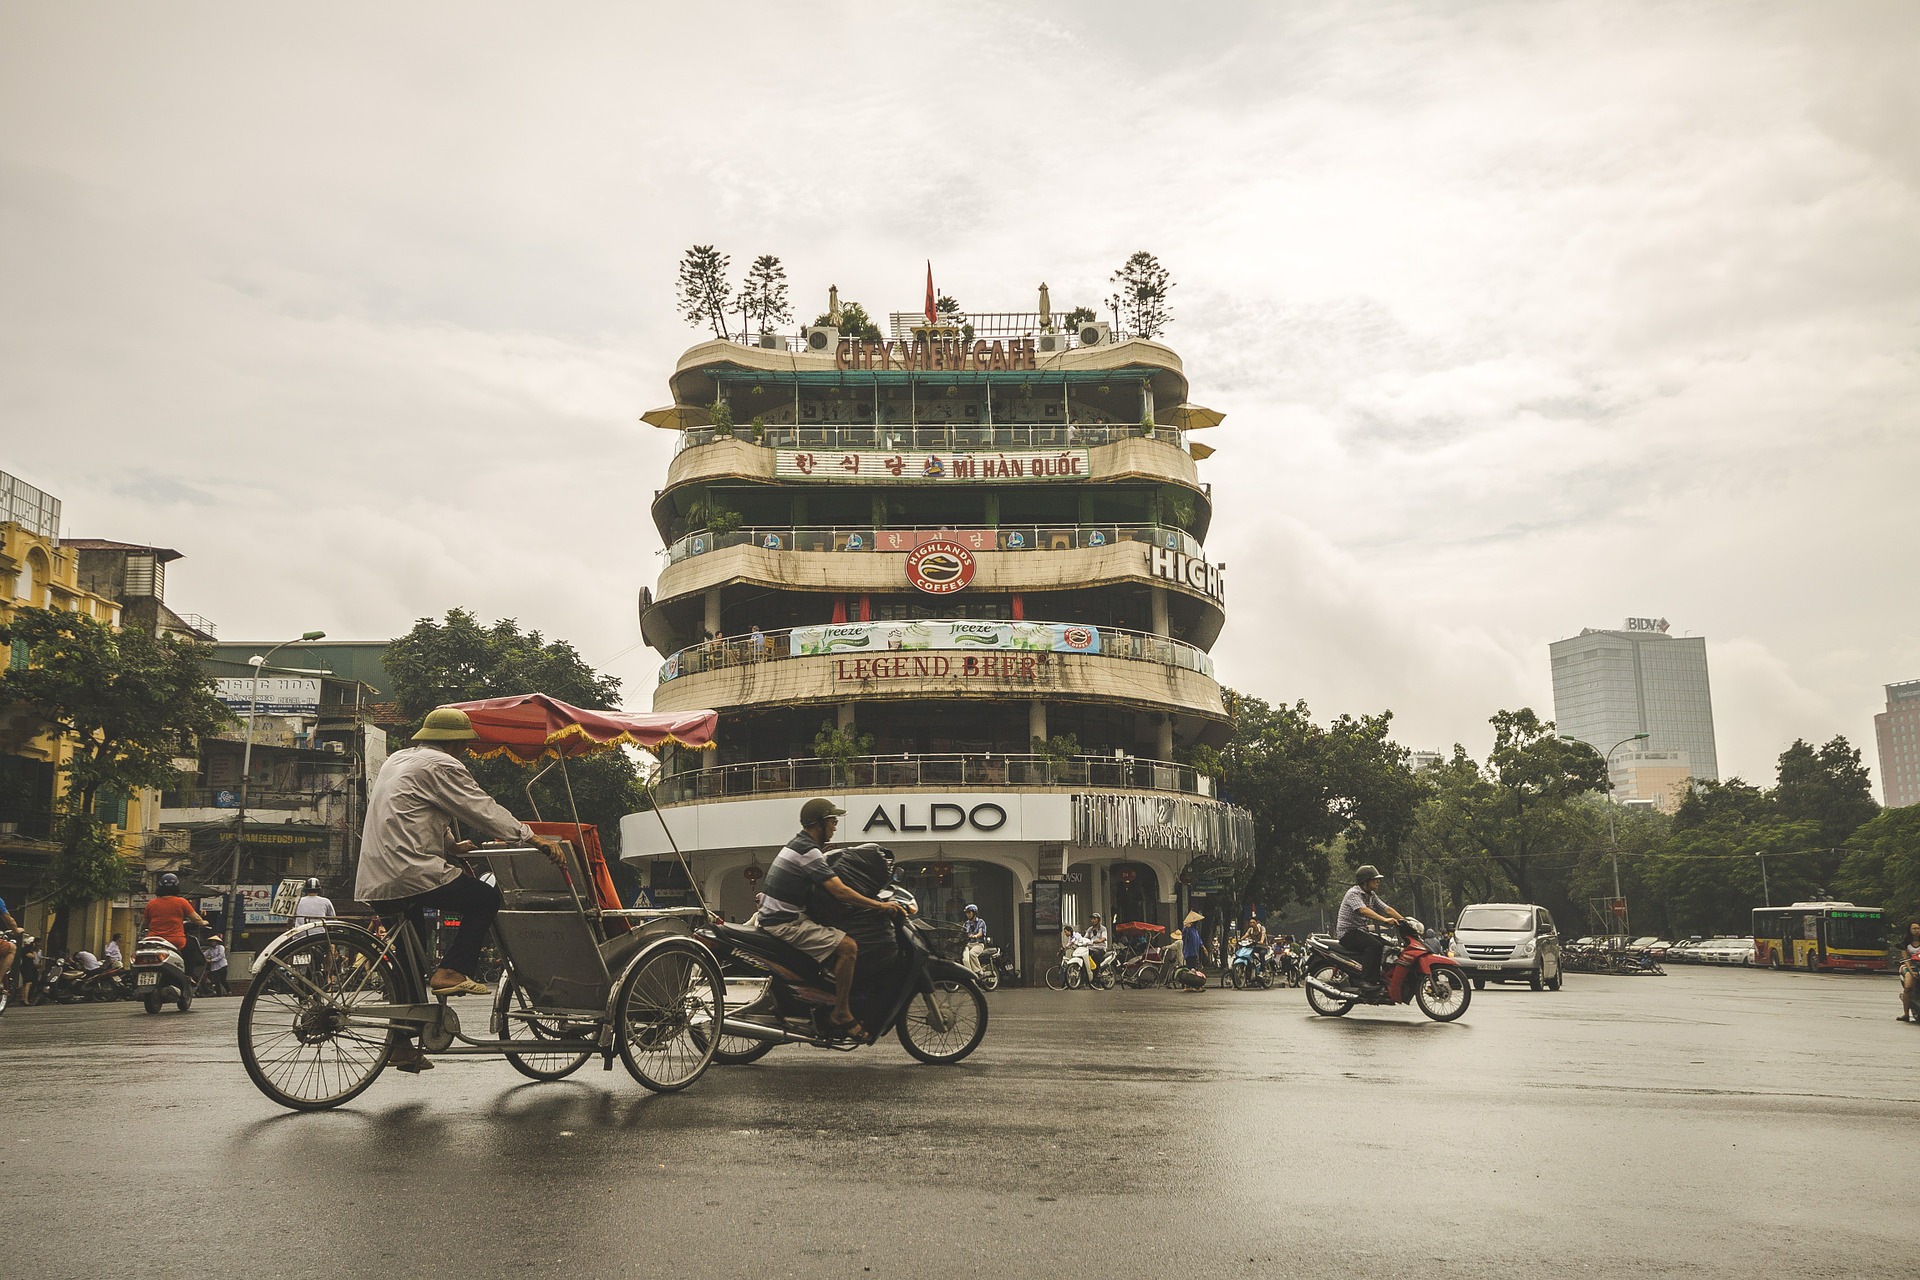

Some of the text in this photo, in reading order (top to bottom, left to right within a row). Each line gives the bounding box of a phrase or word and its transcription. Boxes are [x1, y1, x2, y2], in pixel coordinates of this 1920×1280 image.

[835, 339, 1037, 371] CITY VIEW CAFE
[953, 450, 1082, 478] MÌ HÀN QUỐC
[909, 544, 972, 566] HIGHLANDS
[917, 578, 965, 591] COFFEE
[949, 623, 992, 635] freeze
[1628, 617, 1657, 631] BIDV
[823, 627, 863, 639] freeze
[838, 656, 950, 680] LEGEND
[862, 803, 1008, 831] ALDO
[1139, 824, 1191, 838] SWAROVSKI
[273, 899, 296, 915] 0291
